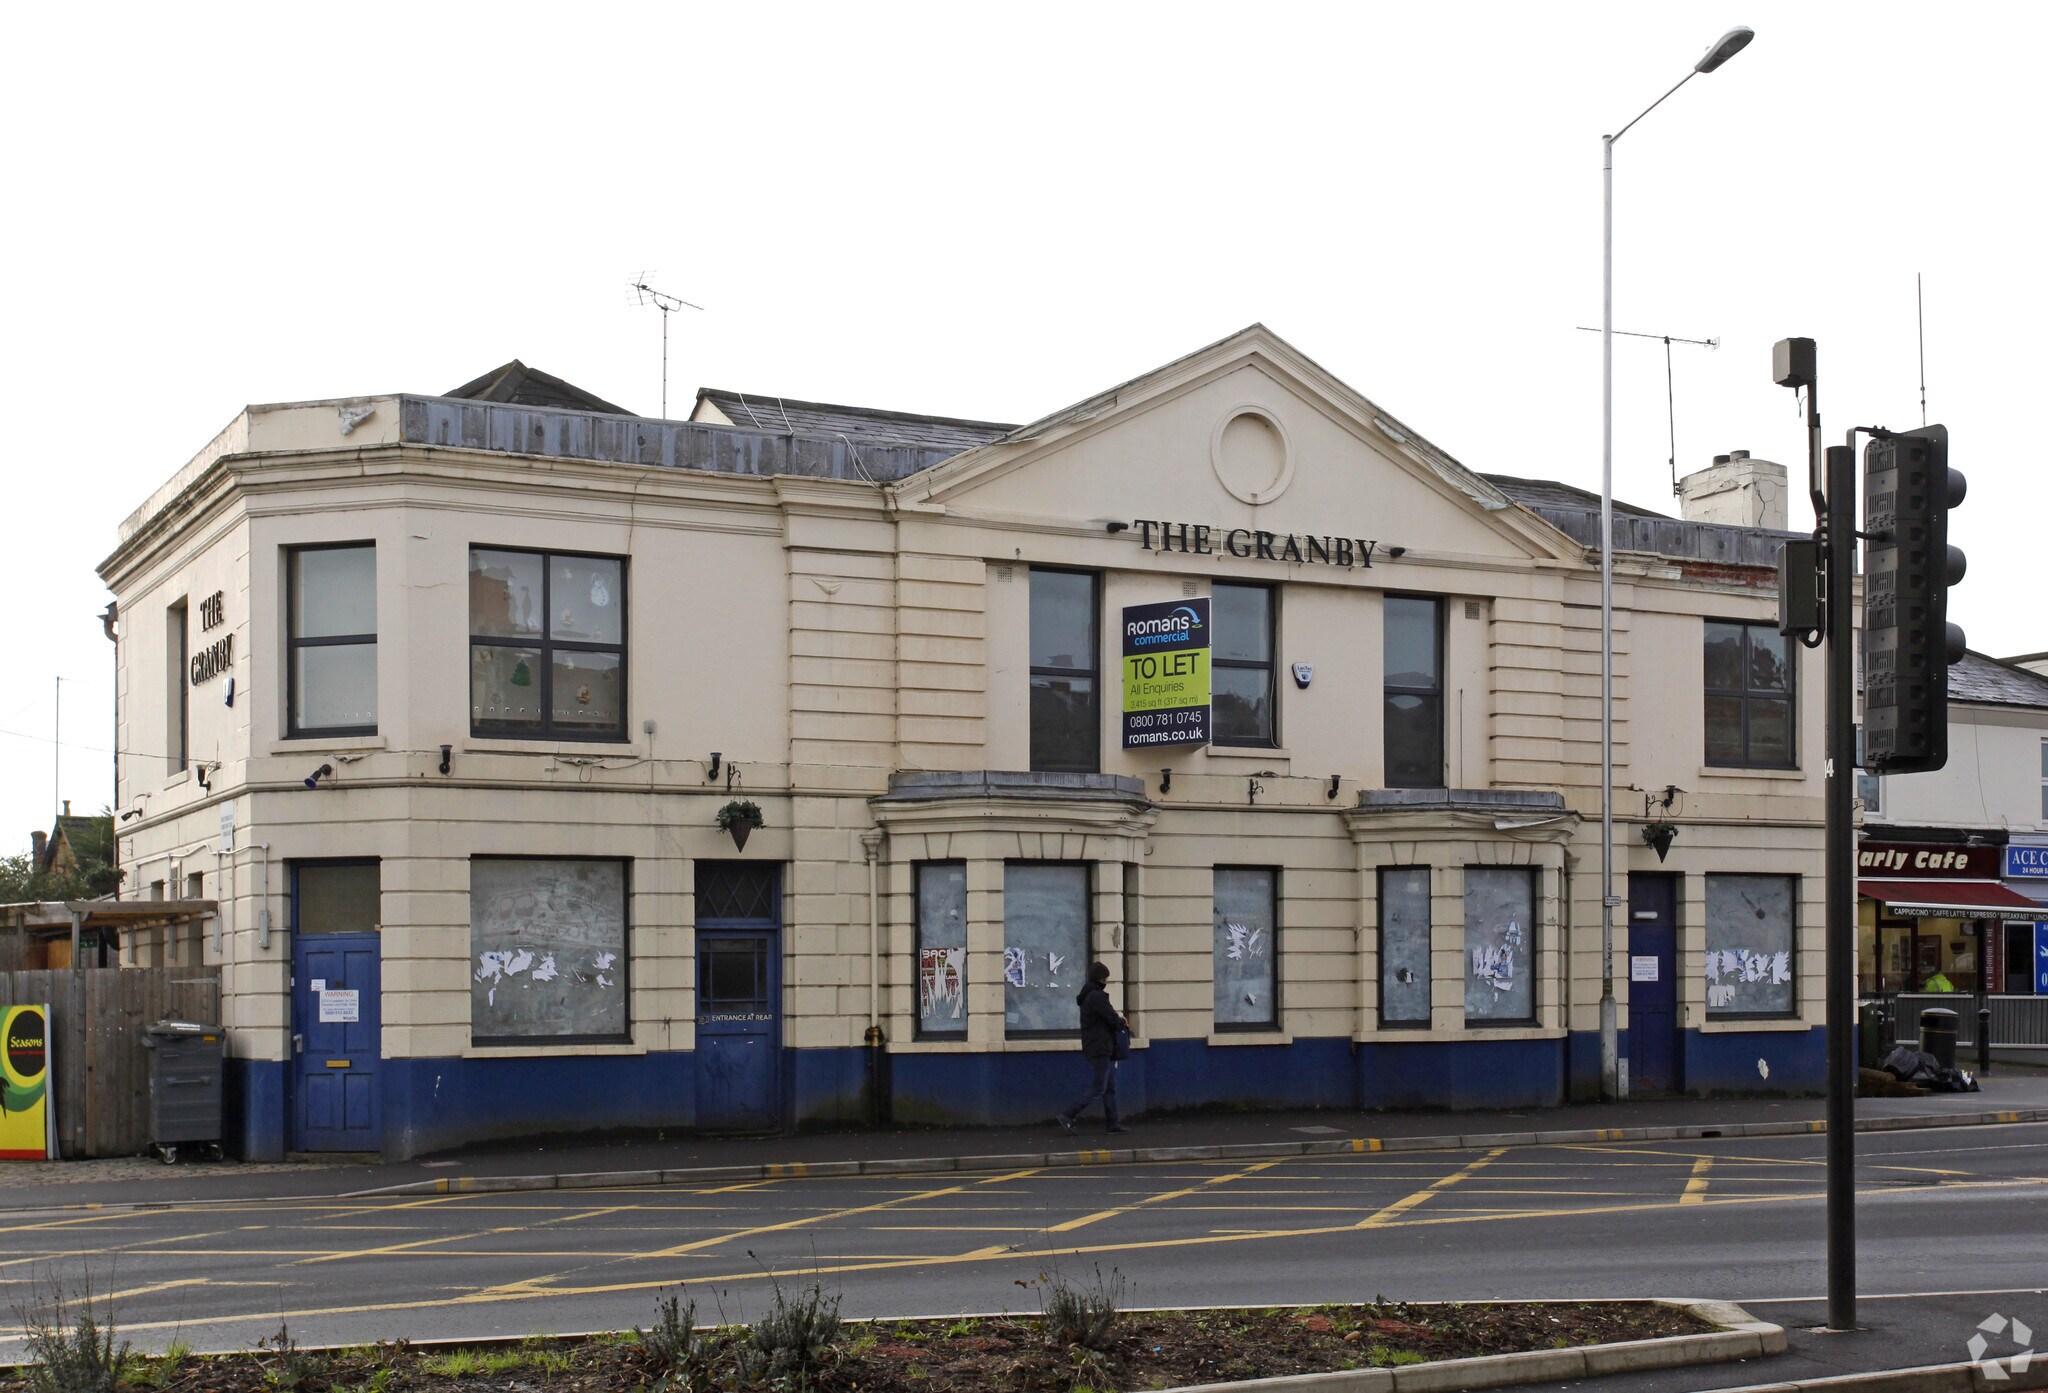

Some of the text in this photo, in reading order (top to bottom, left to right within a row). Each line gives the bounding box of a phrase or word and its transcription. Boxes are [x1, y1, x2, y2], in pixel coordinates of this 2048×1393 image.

[1134, 519, 1377, 568] THE GRANBY
[200, 590, 224, 632] THE
[1134, 630, 1190, 646] commercial
[191, 633, 235, 686] GRANBY
[1130, 652, 1200, 680] TO LET
[1130, 681, 1185, 696] All Enquiries
[1147, 700, 1157, 709] sq
[1164, 696, 1178, 707] (317
[1179, 697, 1188, 706] sq
[1188, 695, 1199, 704] m)
[1130, 711, 1202, 728] 0800 781 0745
[1128, 727, 1203, 744] romans.co.uk
[1914, 850, 1969, 870] Cafe
[2012, 850, 2038, 865] ACE
[1893, 907, 1929, 916] CAPPUCCINO
[1949, 910, 1967, 918] LATTE
[1969, 911, 1997, 919] ESPRESSO
[2000, 912, 2030, 920] BREAKFAST
[10, 1036, 43, 1048] Seasons
